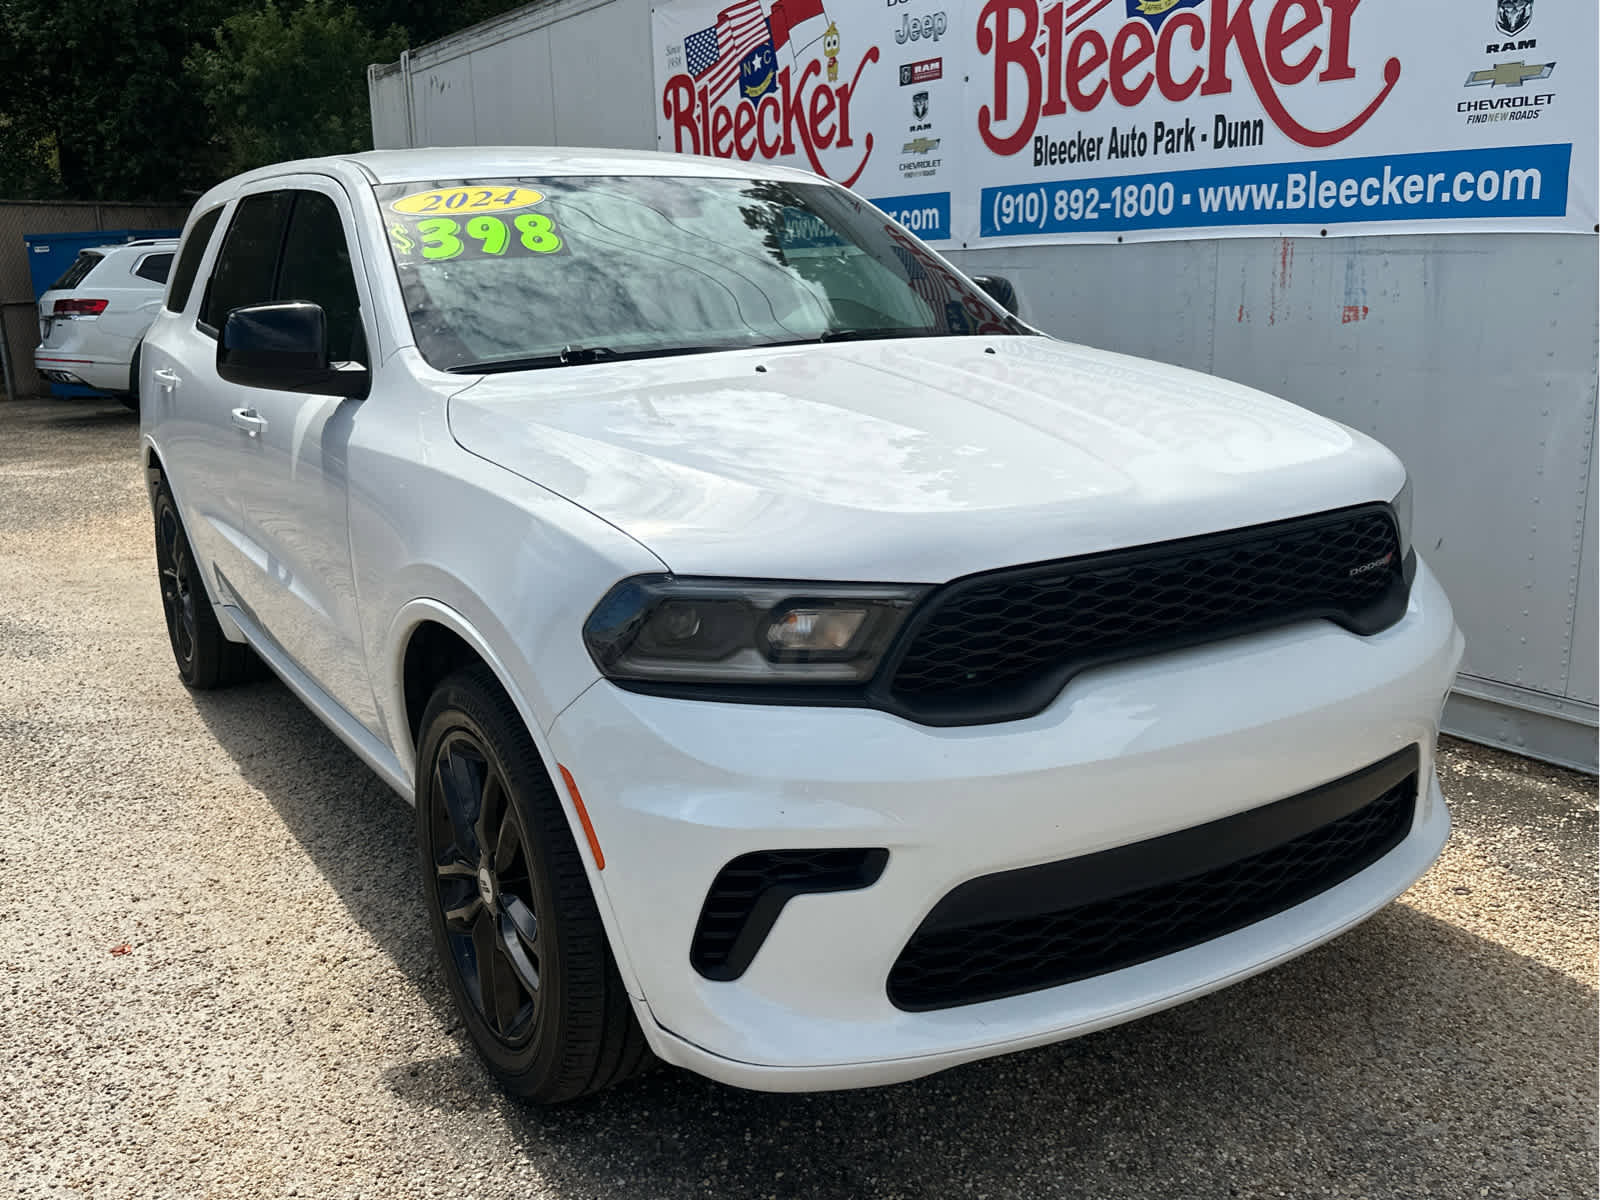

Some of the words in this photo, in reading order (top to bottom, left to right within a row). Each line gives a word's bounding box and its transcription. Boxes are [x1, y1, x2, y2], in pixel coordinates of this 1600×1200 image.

[895, 11, 948, 45] Jeep
[1486, 39, 1537, 54] RAM
[914, 61, 940, 73] RAM
[976, 0, 1401, 156] Bleecker
[662, 46, 880, 188] Bleecker
[1457, 94, 1556, 112] CHEVROLET
[910, 122, 932, 132] RAM
[1033, 130, 1104, 167] Bleecker
[1107, 126, 1147, 160] Auto
[1153, 117, 1196, 155] Park
[1213, 113, 1264, 149] Dunn
[418, 189, 518, 212] 2024
[993, 188, 1047, 231] (910)
[1053, 181, 1174, 221] 892-1800
[1198, 165, 1542, 213] www.Bleecker.com
